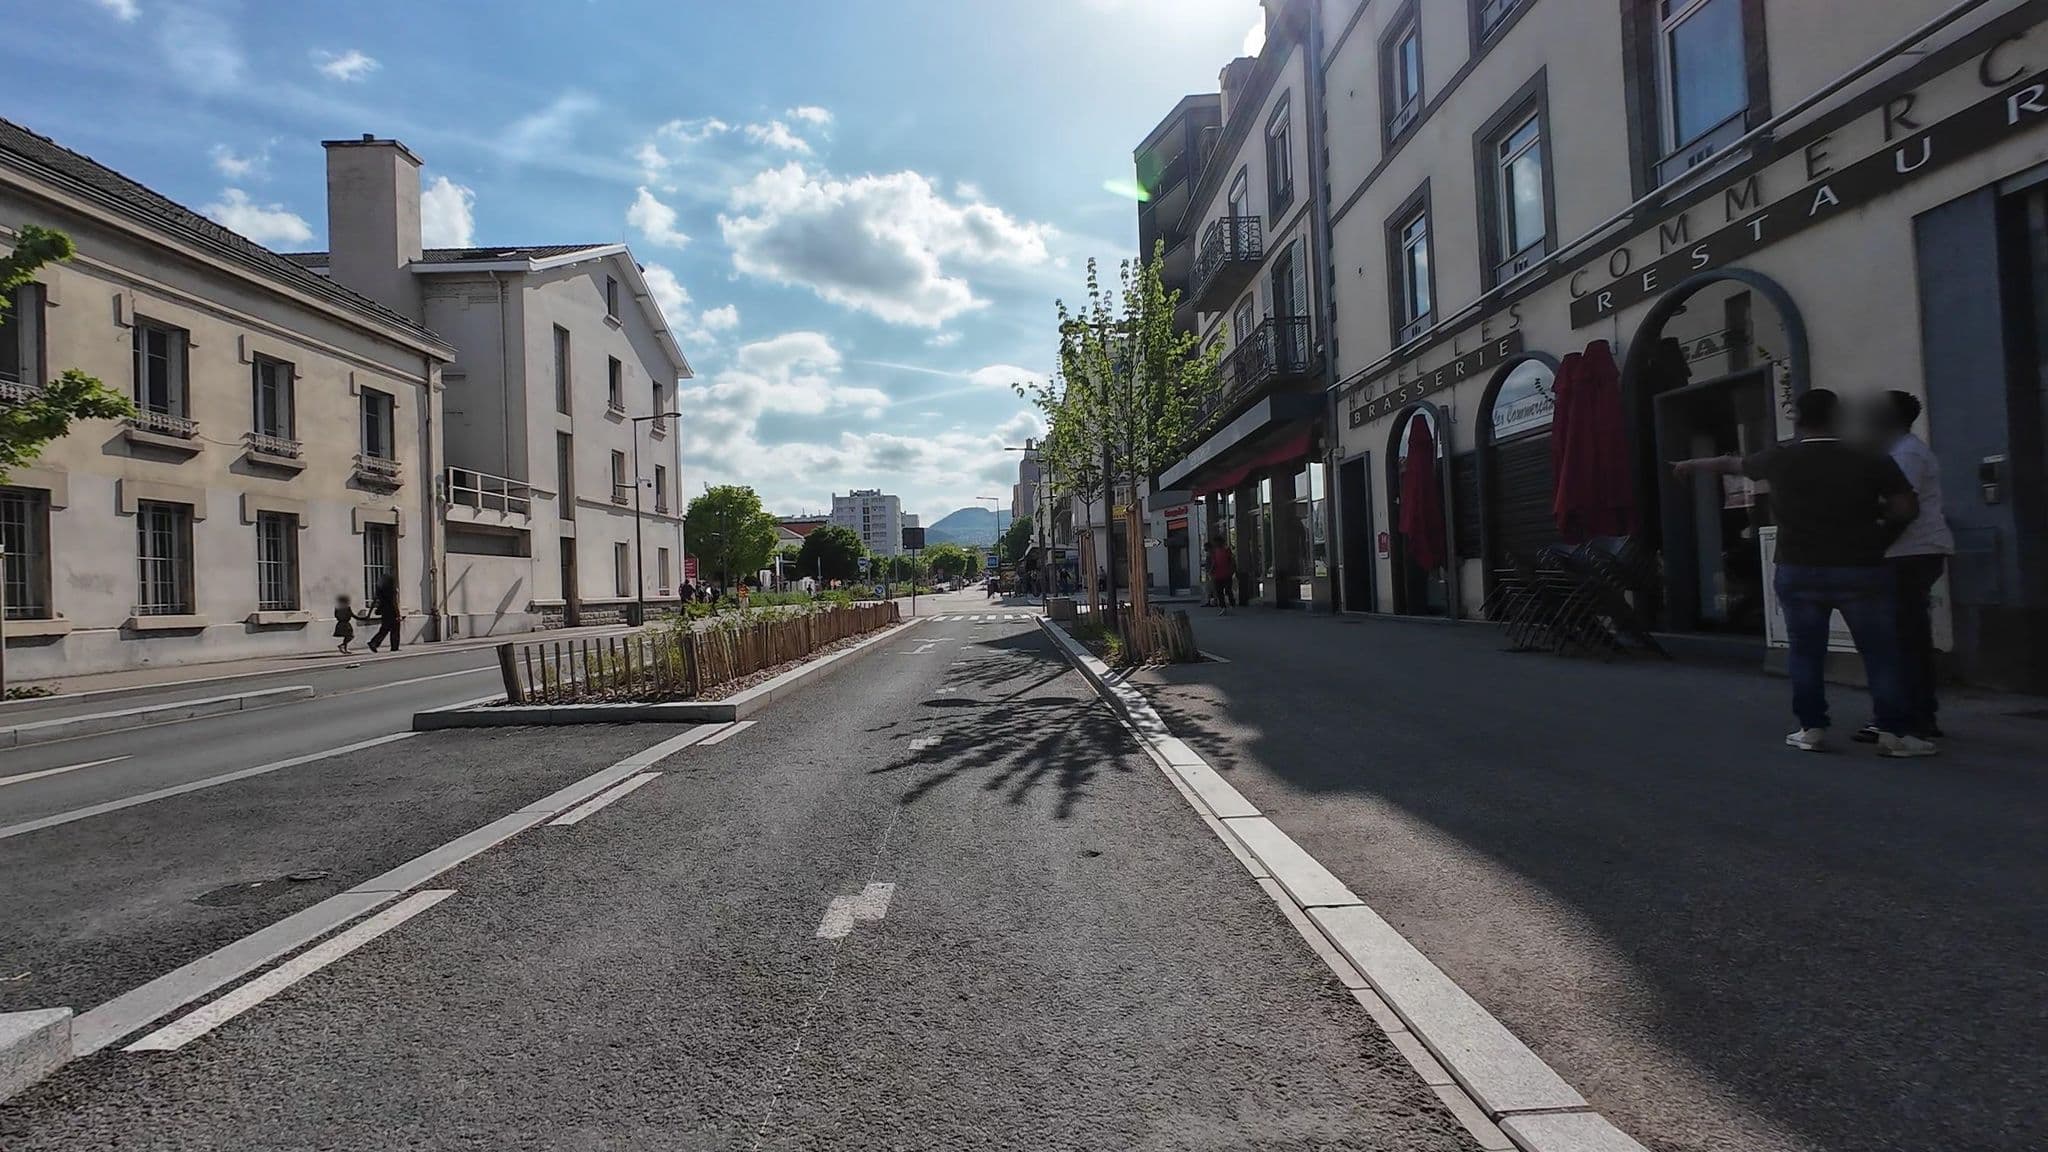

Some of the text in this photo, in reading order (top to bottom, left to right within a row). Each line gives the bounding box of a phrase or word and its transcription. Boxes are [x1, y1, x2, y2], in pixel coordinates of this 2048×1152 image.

[1597, 83, 2048, 312] RESTAUR
[1454, 303, 1521, 356] LES
[1354, 339, 1510, 424] BRASSERIE
